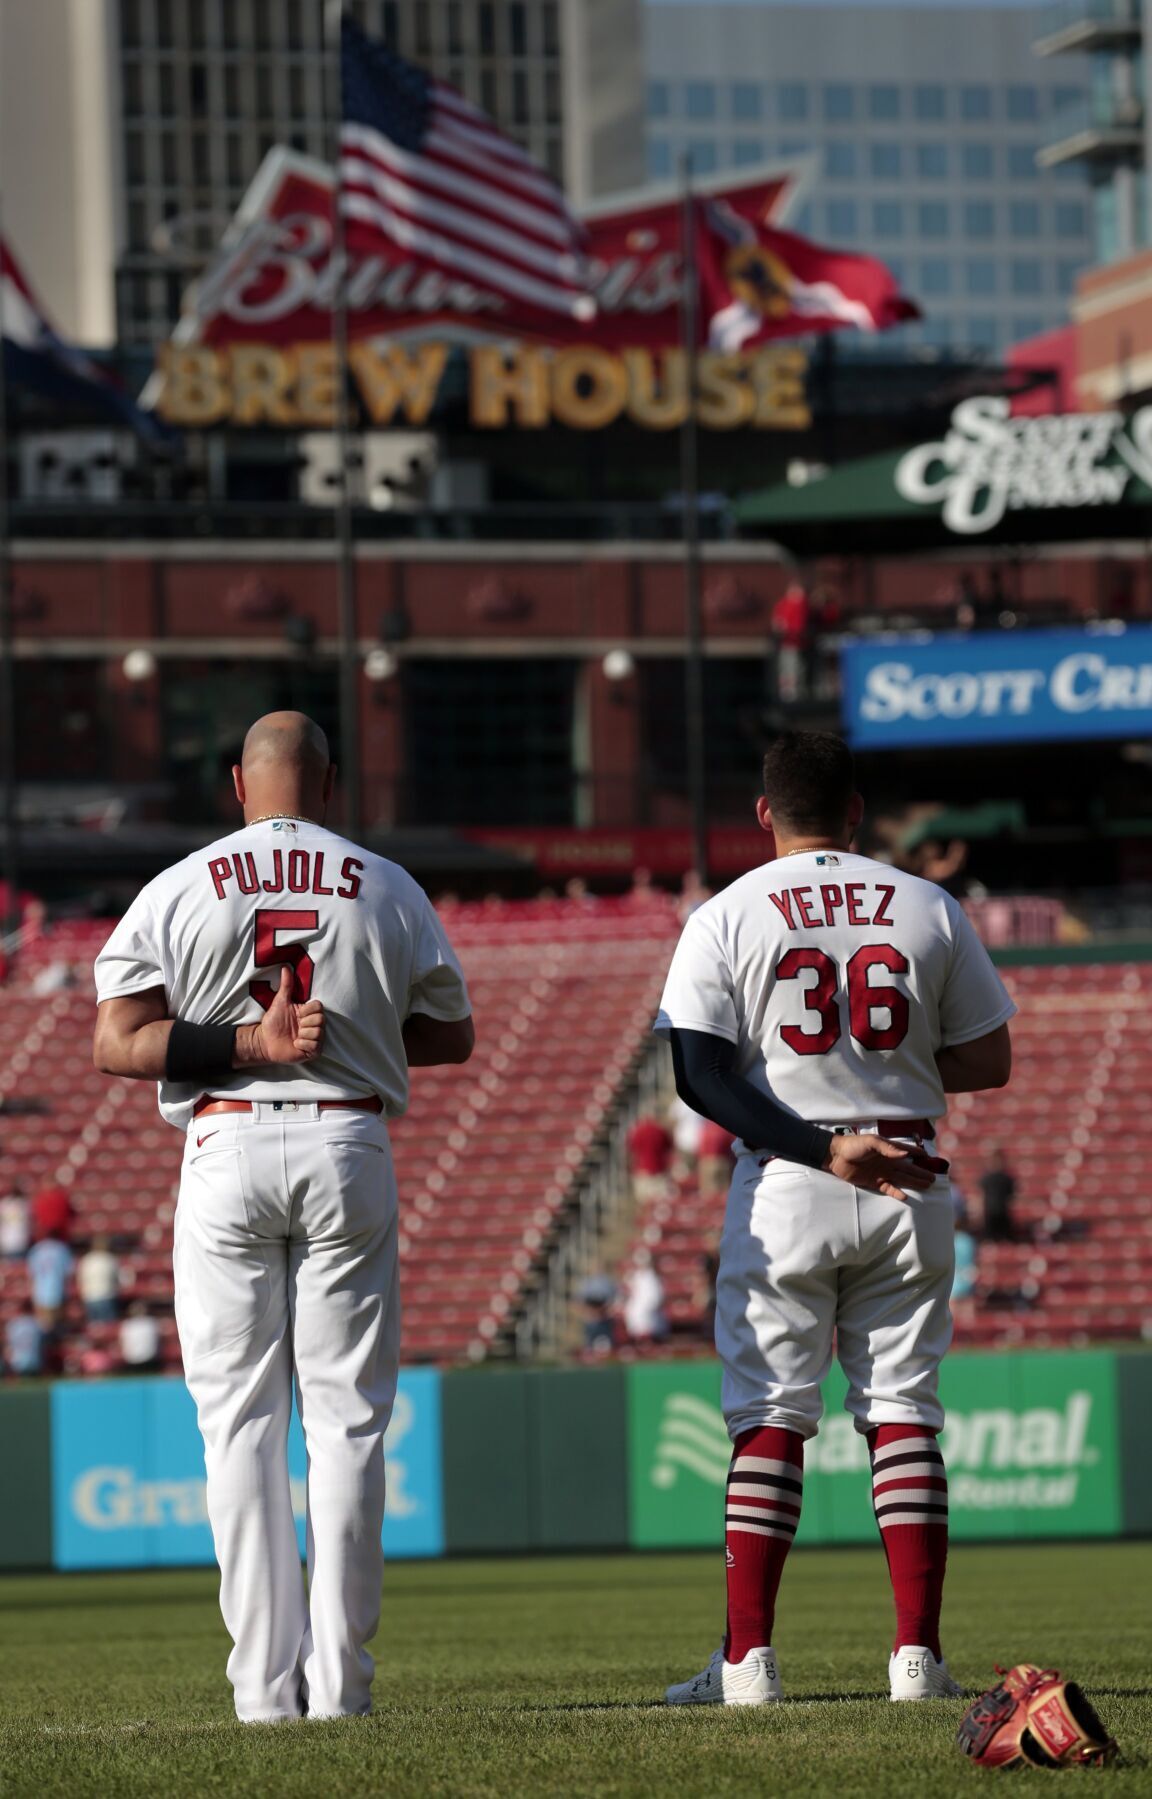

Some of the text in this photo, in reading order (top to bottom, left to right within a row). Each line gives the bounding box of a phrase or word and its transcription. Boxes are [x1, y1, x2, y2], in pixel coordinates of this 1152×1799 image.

[156, 342, 813, 430] BREW HOUSE
[860, 660, 1046, 722] SCOTT
[208, 849, 364, 900] PUJOLS
[768, 882, 896, 930] YEPEZ
[249, 908, 319, 1014] 5
[776, 943, 910, 1056] 36
